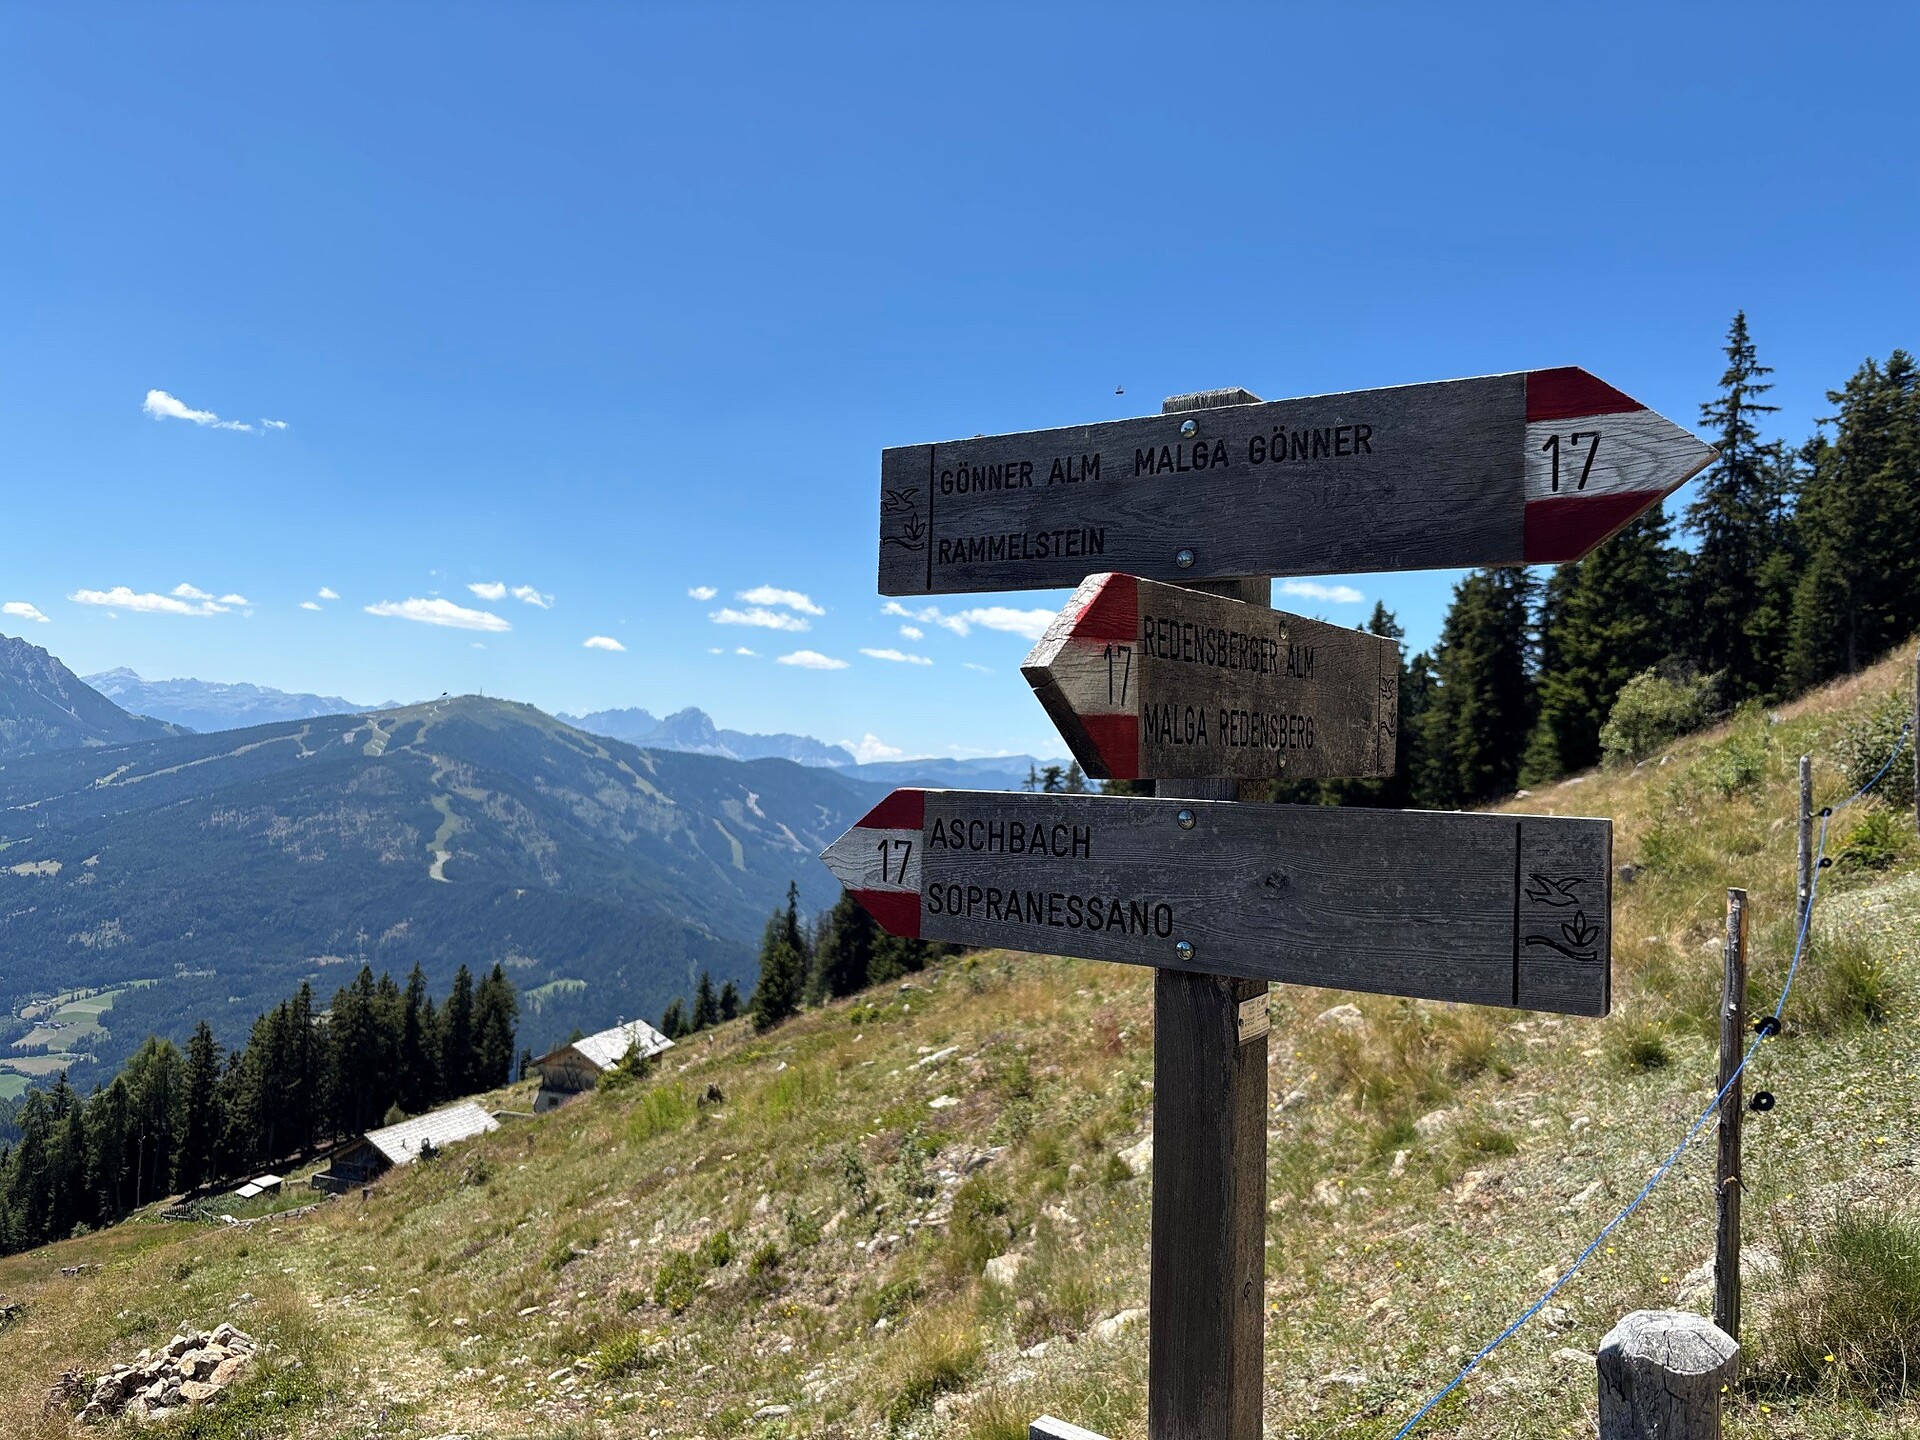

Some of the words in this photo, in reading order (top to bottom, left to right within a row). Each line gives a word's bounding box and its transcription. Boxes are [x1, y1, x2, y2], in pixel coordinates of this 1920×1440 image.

[940, 461, 1033, 495] GÖNNER
[1048, 455, 1100, 486] ALM
[1134, 439, 1230, 478] MALGA
[1248, 424, 1373, 466] GÖNNER
[1542, 431, 1600, 492] 17
[938, 528, 1105, 565] RAMMELSTEIN
[1103, 643, 1133, 706] 17
[1143, 615, 1278, 675] REDENSBERGER
[1286, 644, 1315, 680] ALM
[1143, 703, 1209, 747] MALGA
[1219, 708, 1314, 750] REDENSBERG
[877, 839, 912, 884] 17
[929, 818, 1091, 860] ASCHBACH
[927, 882, 1174, 938] SOPRANESSANO
